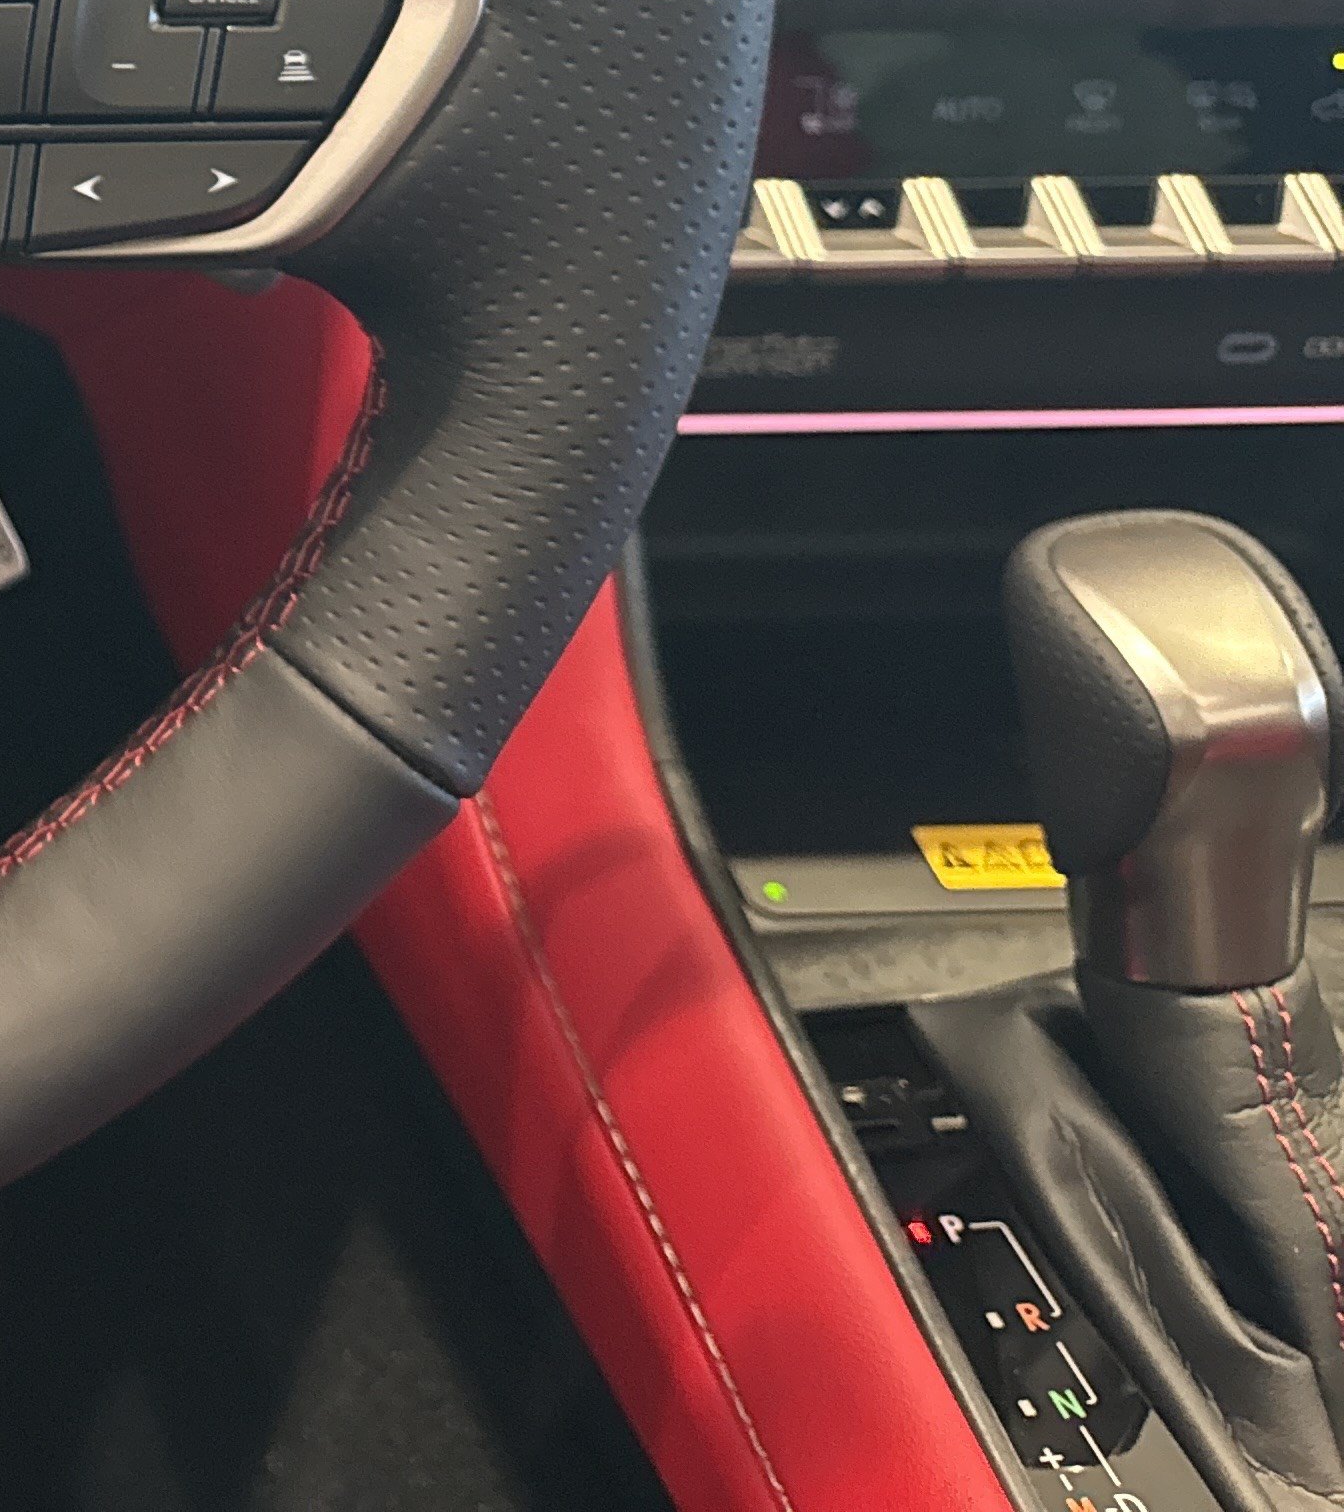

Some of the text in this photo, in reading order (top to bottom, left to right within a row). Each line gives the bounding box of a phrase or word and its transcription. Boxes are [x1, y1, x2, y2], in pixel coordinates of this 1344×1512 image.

[939, 1214, 965, 1244] P
[1017, 1301, 1050, 1332] R
[1049, 1388, 1086, 1420] N
